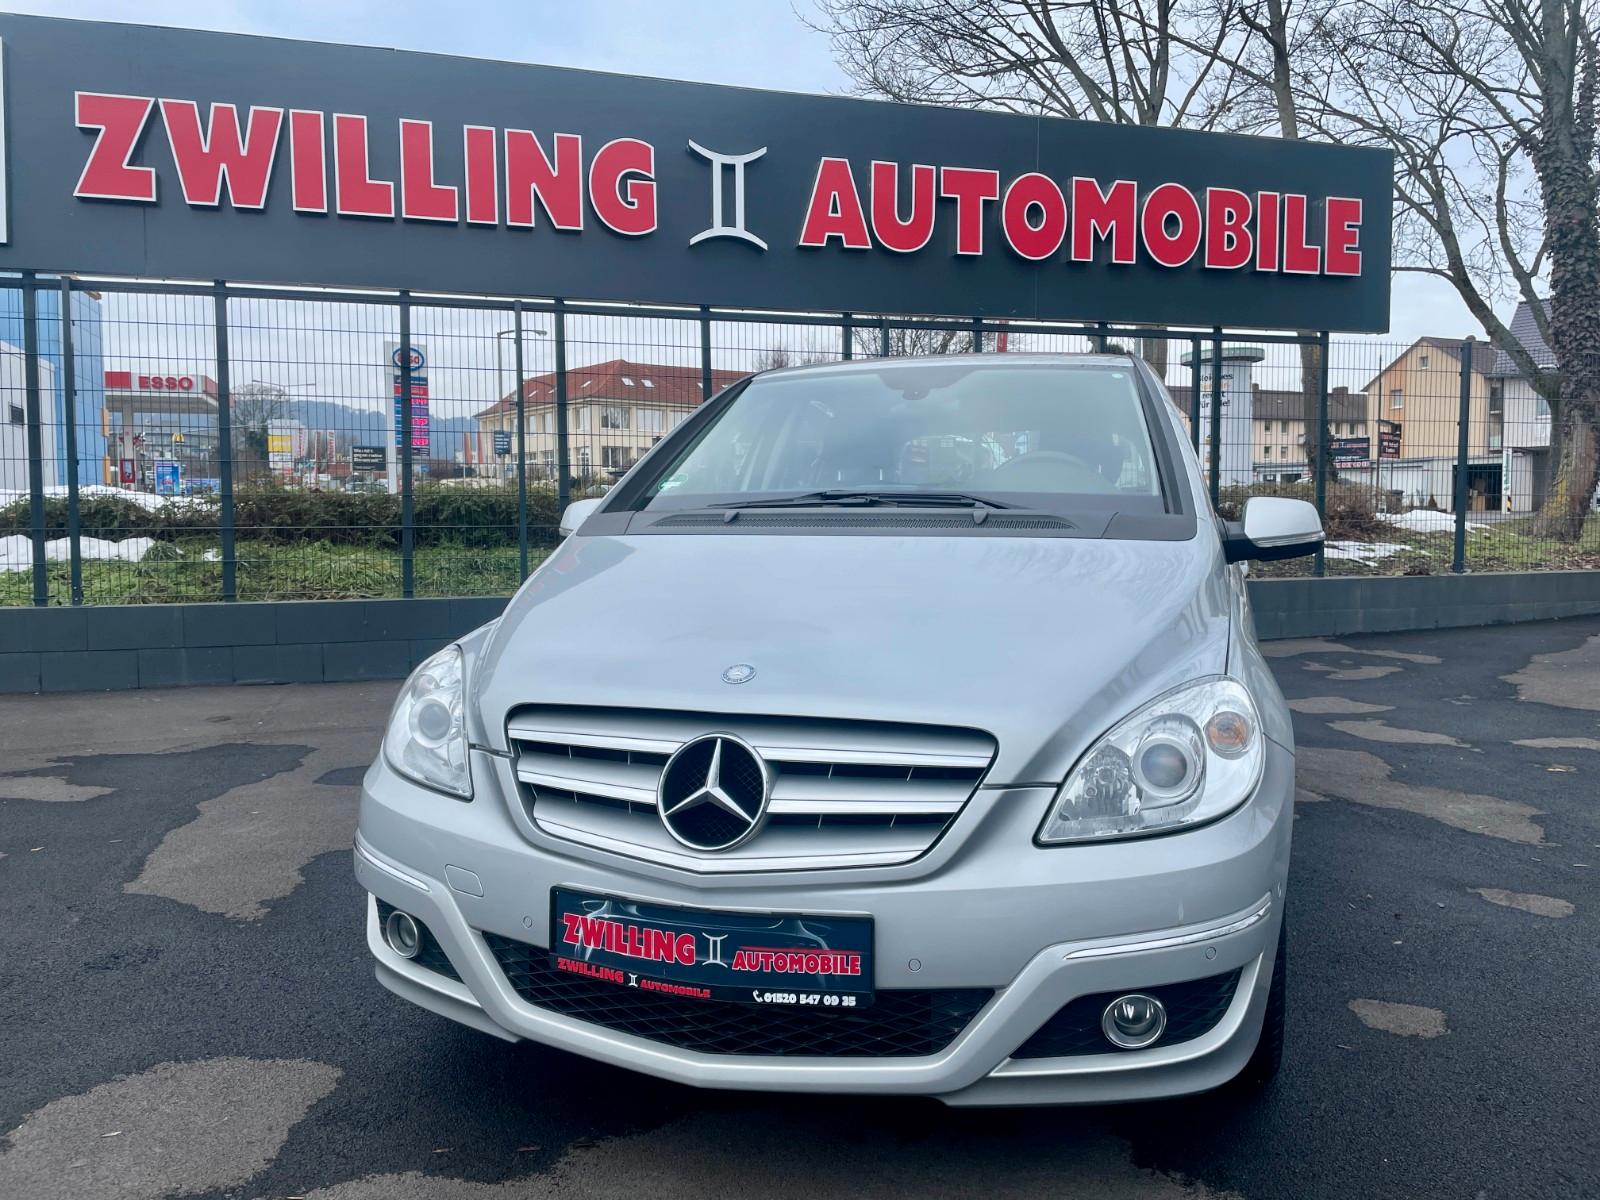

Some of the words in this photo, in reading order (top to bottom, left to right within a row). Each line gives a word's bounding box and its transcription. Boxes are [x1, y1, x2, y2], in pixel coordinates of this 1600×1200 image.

[74, 91, 658, 236] ZWILLING
[799, 156, 1362, 276] AUTOMOBILE
[138, 376, 193, 390] ESSO
[563, 913, 695, 966] ZWILLING
[732, 950, 861, 975] AUTOMOBILE
[557, 956, 625, 984] ZWILLING
[639, 979, 711, 999] AUTOMOBILE
[763, 992, 797, 1004] 01520
[799, 994, 821, 1005] 547
[823, 995, 840, 1006] 09
